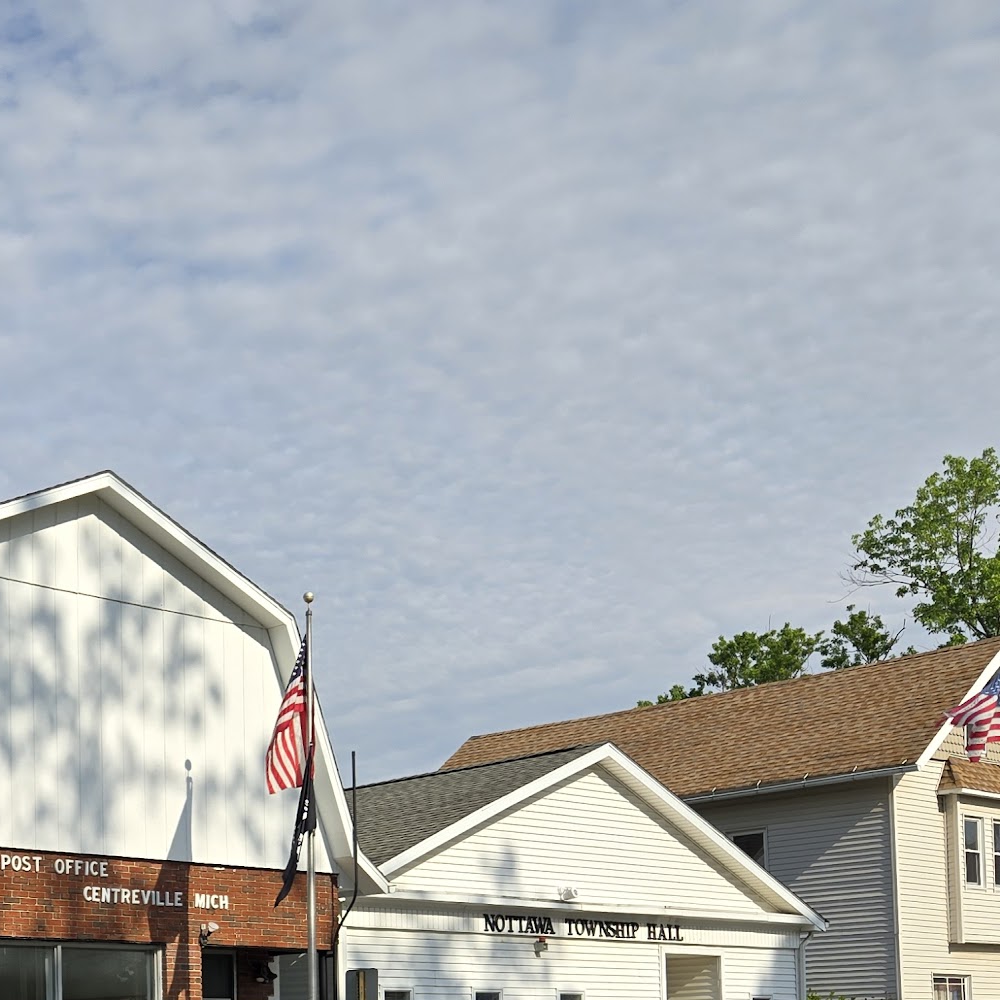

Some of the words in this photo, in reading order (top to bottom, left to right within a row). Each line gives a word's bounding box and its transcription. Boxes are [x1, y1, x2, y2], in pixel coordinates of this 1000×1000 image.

[0, 854, 43, 873] POST
[54, 858, 109, 878] OFFICE
[83, 886, 183, 907] CENTREVILLE
[194, 893, 229, 910] MICH
[483, 913, 555, 935] NOTTAWA
[565, 917, 639, 939] TOWNSHIP
[647, 923, 684, 942] HALL
